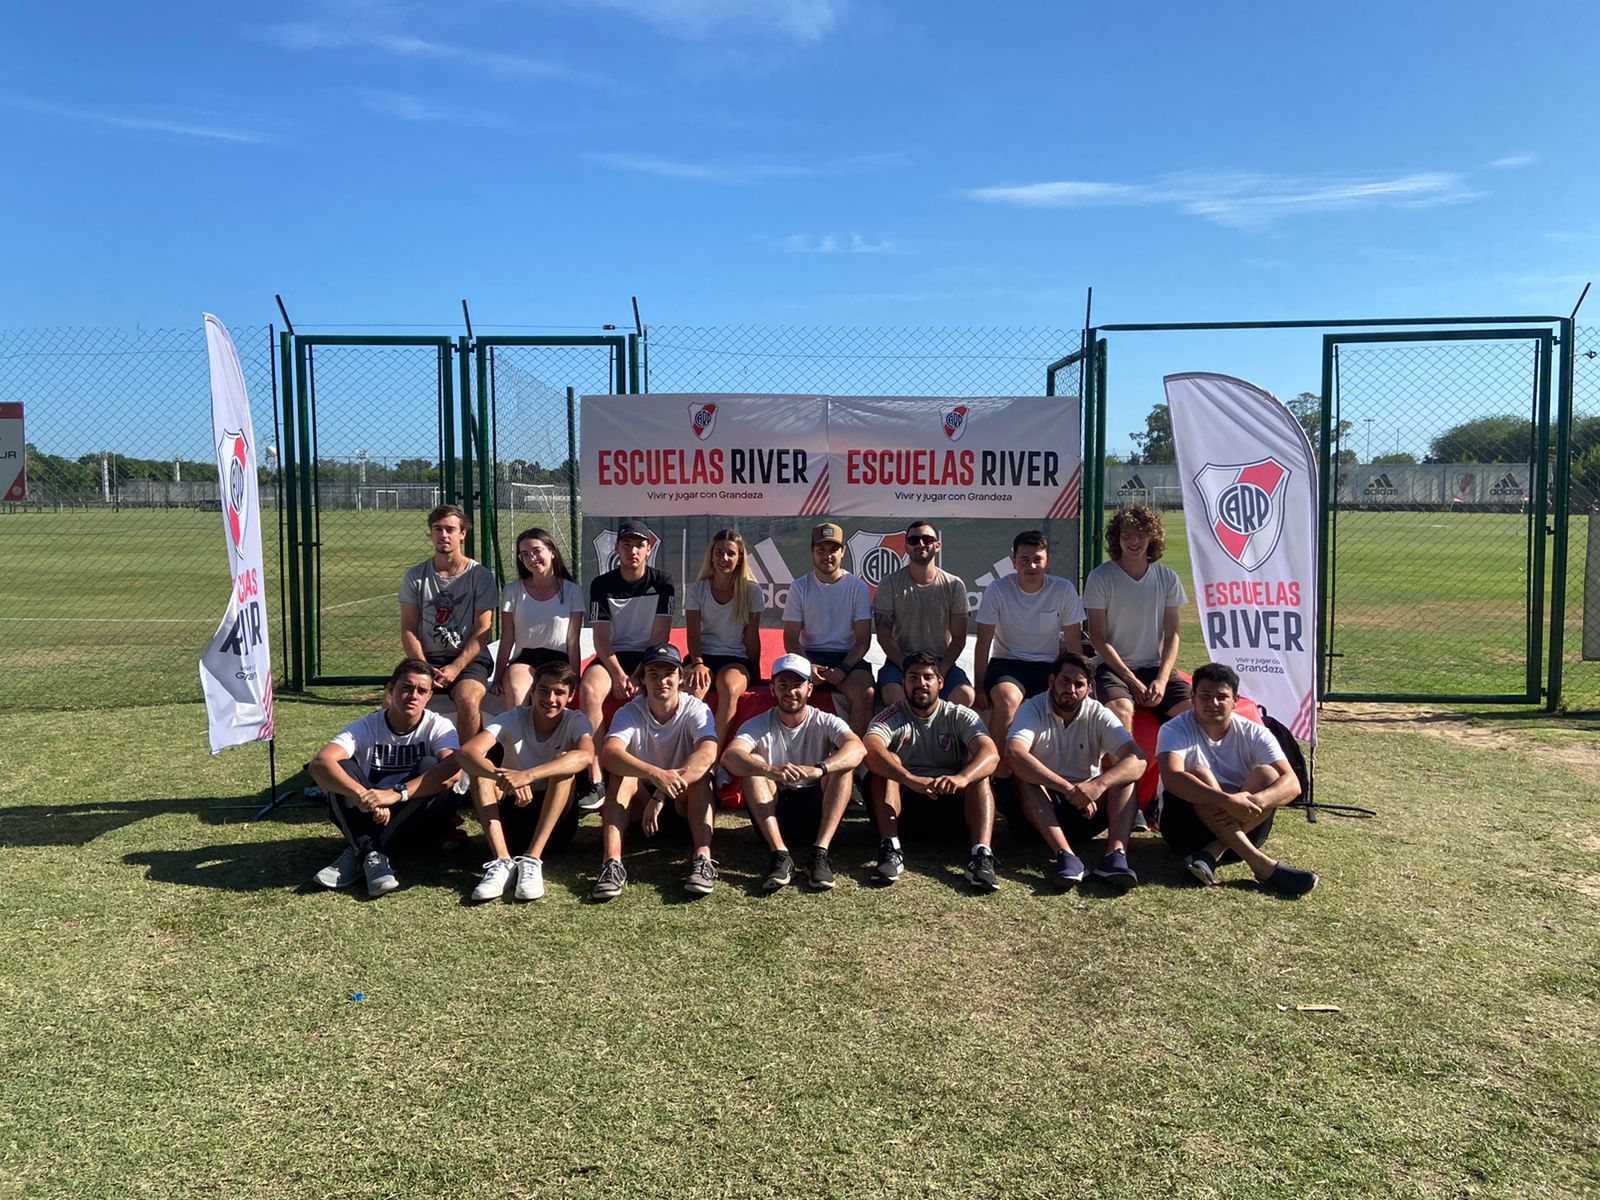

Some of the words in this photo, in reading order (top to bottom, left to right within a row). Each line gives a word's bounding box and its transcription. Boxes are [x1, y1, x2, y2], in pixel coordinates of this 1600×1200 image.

[598, 448, 724, 486] ESCUELAS
[731, 448, 809, 484] RIVER
[847, 449, 975, 486] ESCUELAS
[981, 450, 1059, 487] RIVER
[647, 491, 667, 500] Vivir
[668, 493, 675, 501] y
[675, 491, 698, 501] jugar
[718, 490, 763, 500] Grandeza
[894, 491, 915, 500] Vivir
[916, 493, 923, 501] y
[922, 491, 947, 502] jugar
[948, 492, 966, 500] con
[967, 492, 1013, 501] Grandeza
[1363, 486, 1399, 496] adidas
[1489, 486, 1524, 496] adidas
[1219, 485, 1269, 533] CARP
[1204, 581, 1301, 608] ESCUELAS
[1206, 609, 1305, 652] RIVER
[1236, 663, 1285, 674] Grandeza
